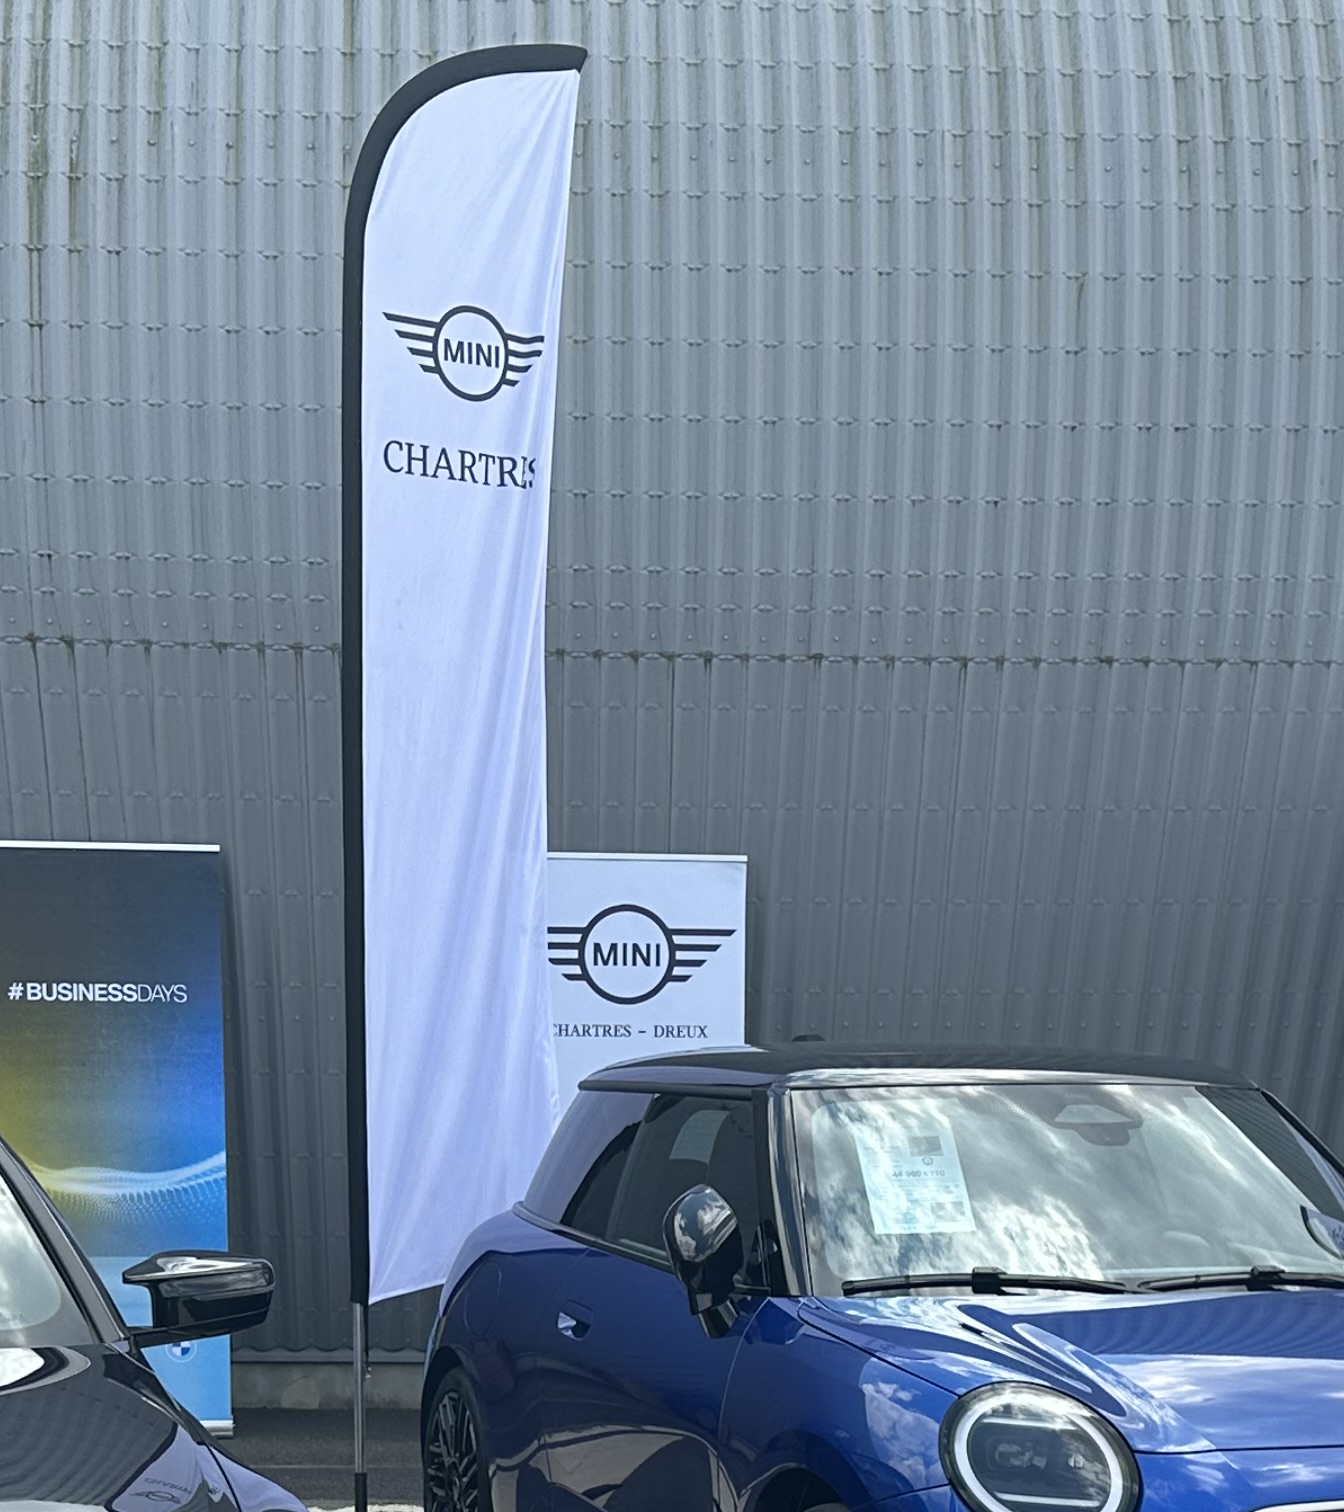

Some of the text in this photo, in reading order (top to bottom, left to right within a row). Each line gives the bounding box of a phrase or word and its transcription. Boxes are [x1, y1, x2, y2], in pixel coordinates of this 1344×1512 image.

[443, 337, 501, 369] MINI
[592, 942, 662, 968] MINI
[7, 981, 188, 1004] #BUSINESSDAYS
[653, 1023, 709, 1040] DREUX
